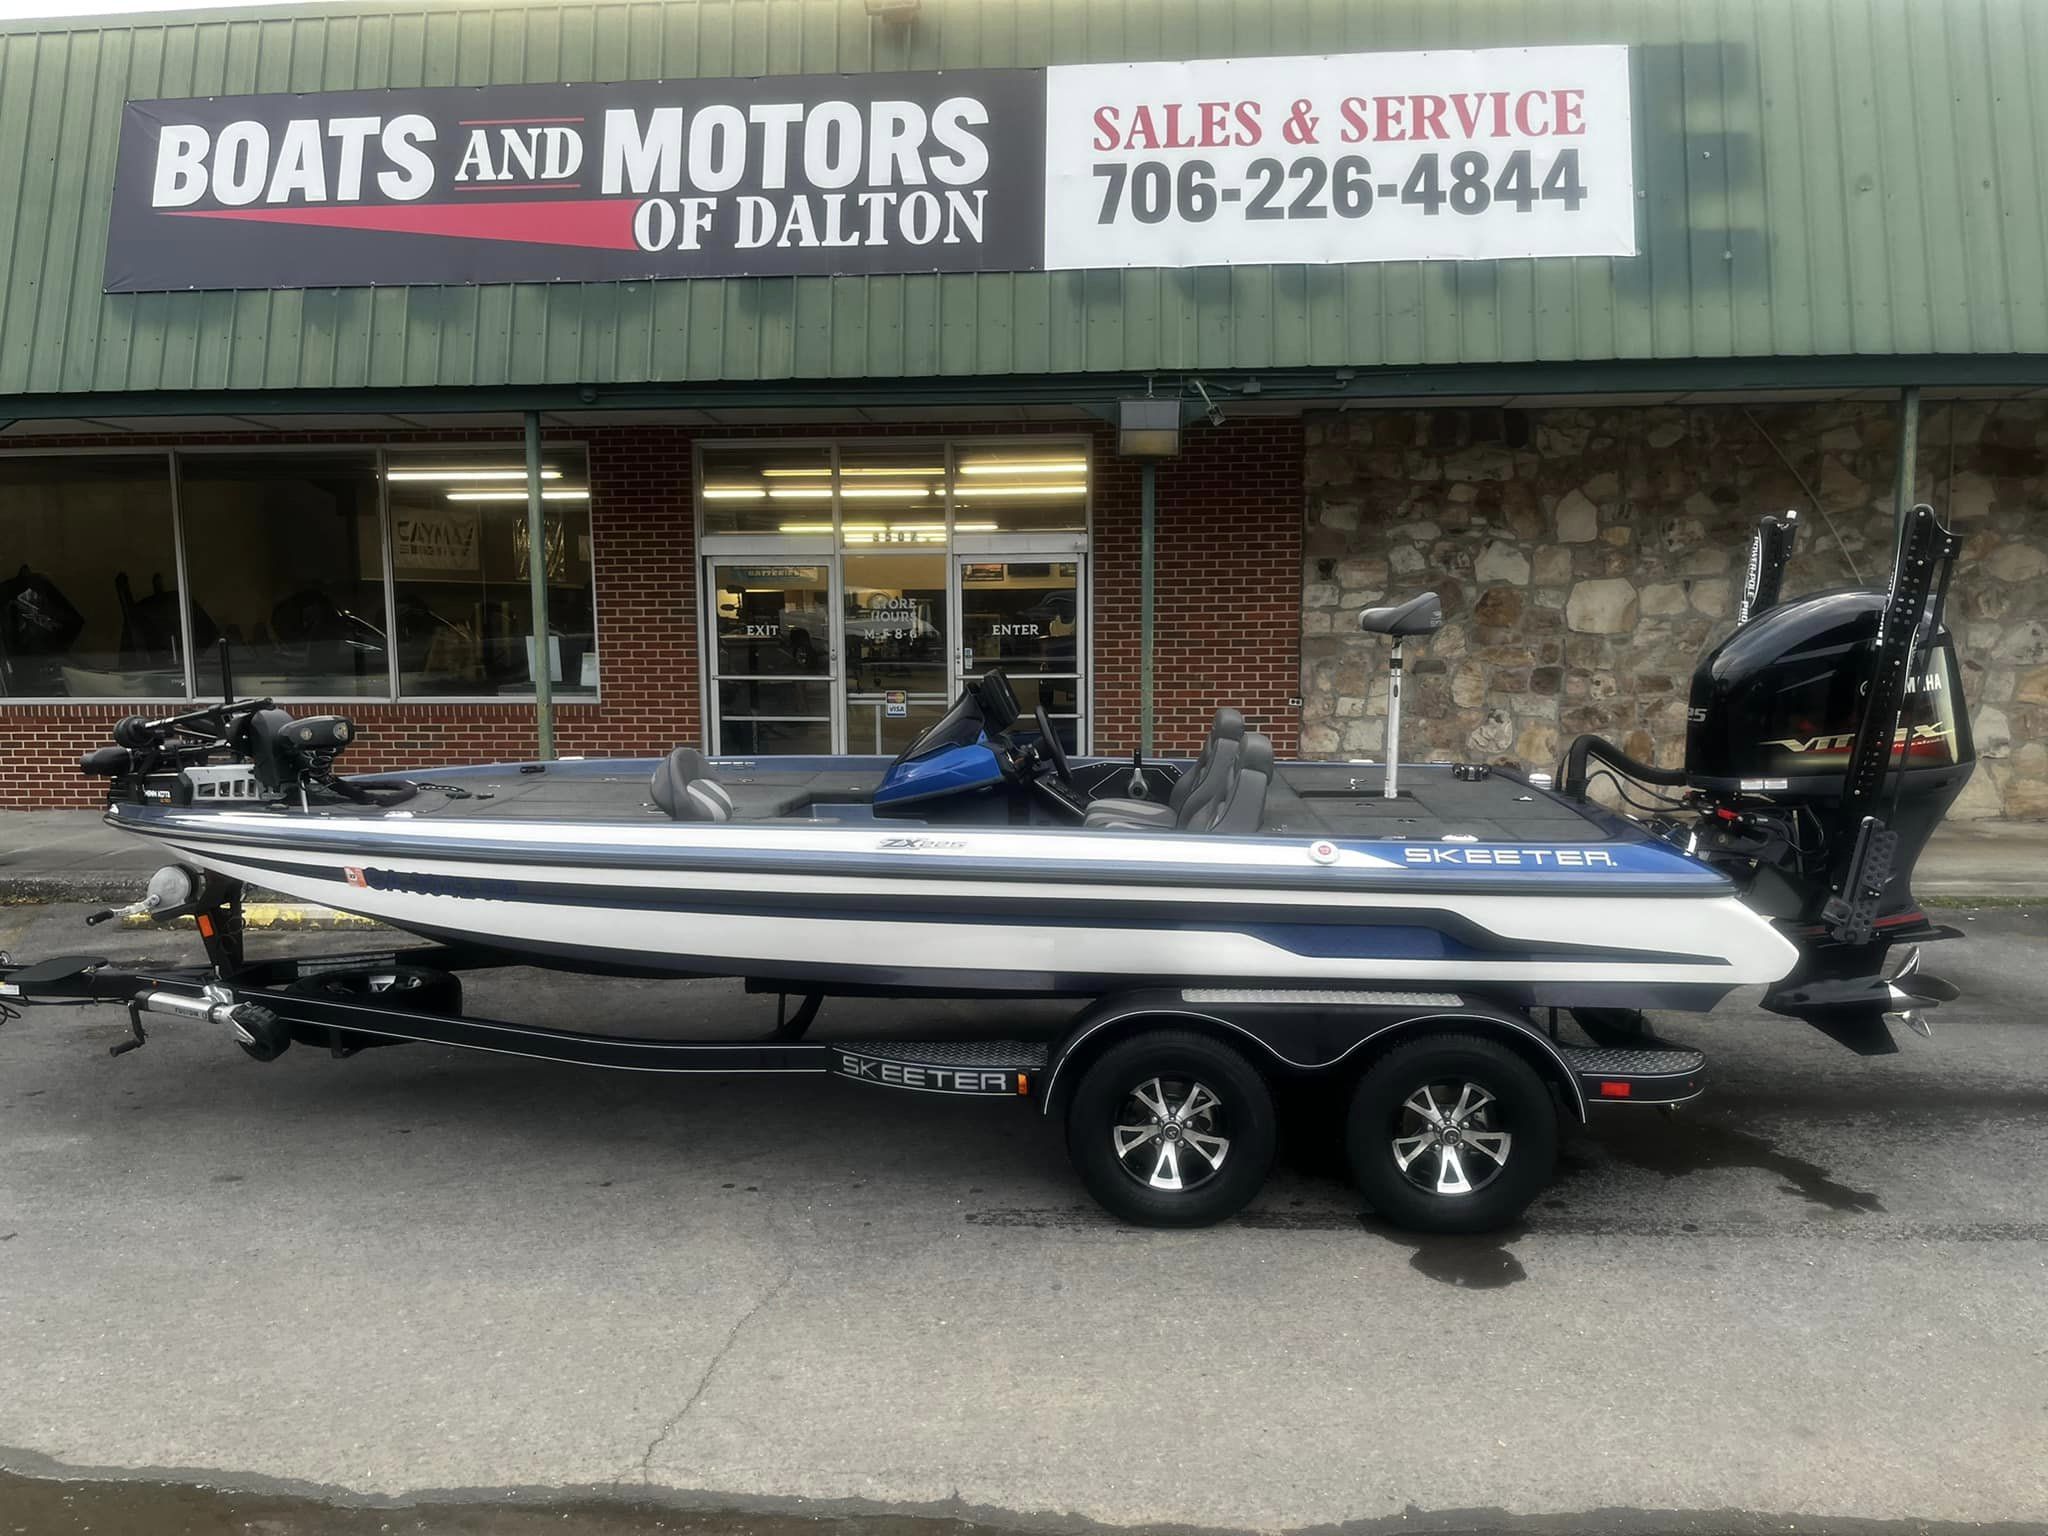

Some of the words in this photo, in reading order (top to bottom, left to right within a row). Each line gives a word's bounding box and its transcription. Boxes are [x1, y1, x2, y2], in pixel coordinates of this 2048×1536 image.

[1093, 100, 1263, 152] SALES
[1281, 98, 1319, 145] &
[1340, 89, 1587, 143] SERVICE
[152, 114, 437, 208] BOATS
[454, 126, 584, 182] AND
[601, 97, 990, 195] MOTORS
[1092, 148, 1589, 225] 706-226-4844
[633, 197, 718, 253] OF
[734, 190, 989, 249] DALTON
[746, 624, 779, 636] EXIT
[871, 610, 917, 622] HOURS
[991, 623, 1040, 636] ENTER
[889, 704, 905, 713] VISA
[842, 1055, 1007, 1091] SKEETER
